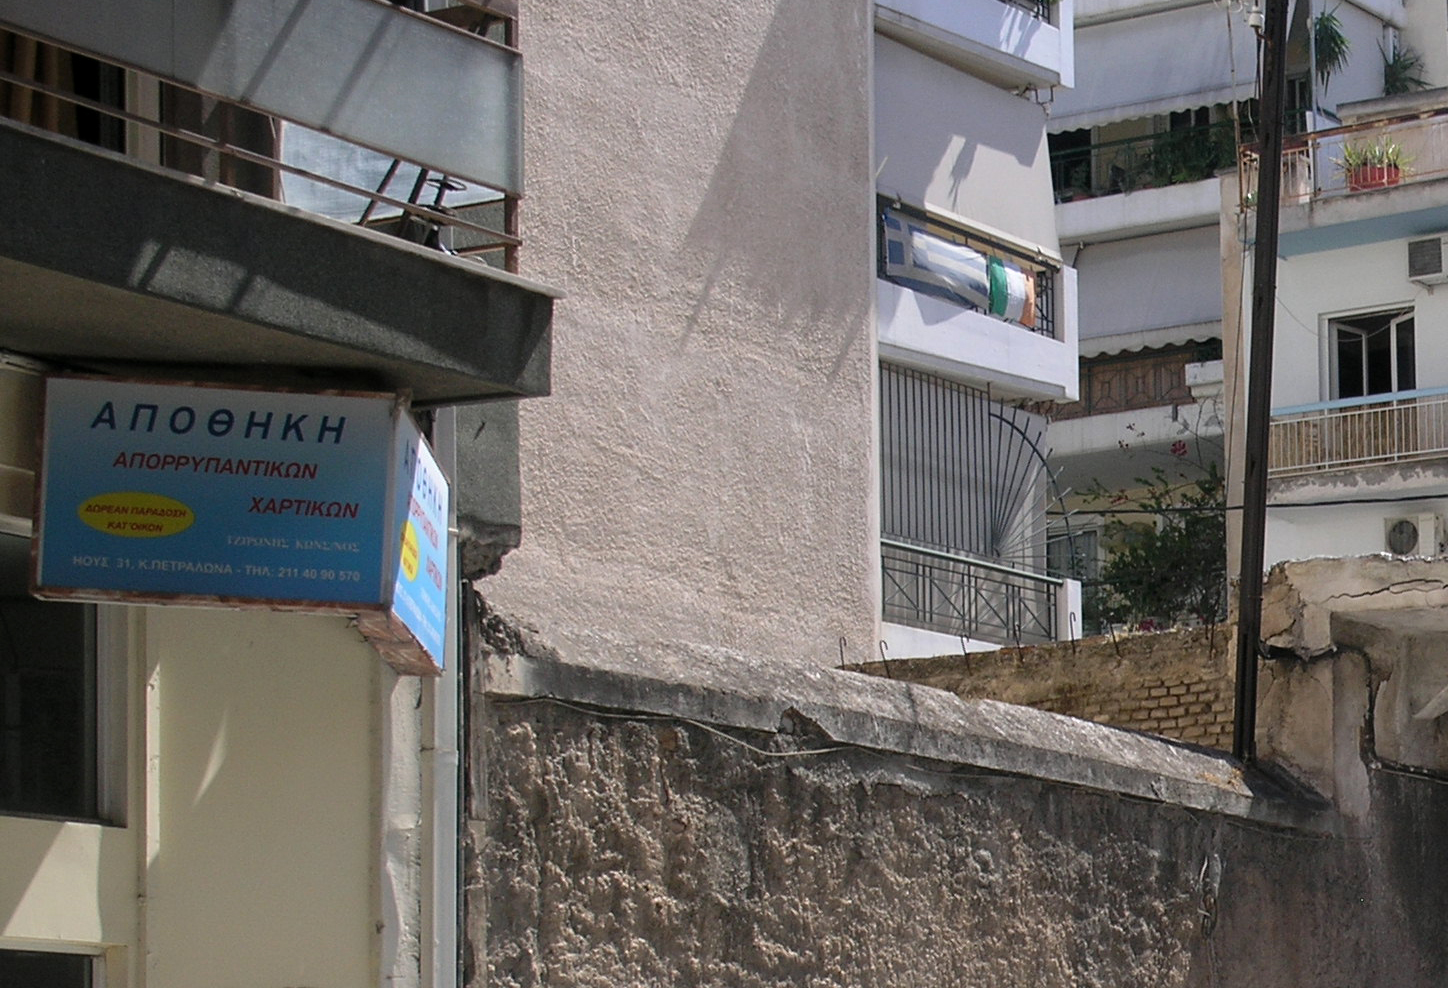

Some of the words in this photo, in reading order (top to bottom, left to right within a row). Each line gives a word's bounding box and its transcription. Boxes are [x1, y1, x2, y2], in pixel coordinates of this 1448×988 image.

[90, 400, 346, 444] ΑΠΟΘΗΚΗ
[112, 451, 318, 480] ΑΠΟΡΡΥΠΑΝΤΙΚΩΝ
[248, 496, 360, 519] ΧΑΡΤΙΚΩΝ
[73, 555, 109, 568] ΗΟΥΣ
[138, 559, 233, 574] Κ.ΠΕΤΡΑΛΩΝΑ
[278, 567, 298, 578] 211
[303, 568, 317, 579] 40
[321, 569, 335, 580] 90
[339, 570, 361, 582] 570
